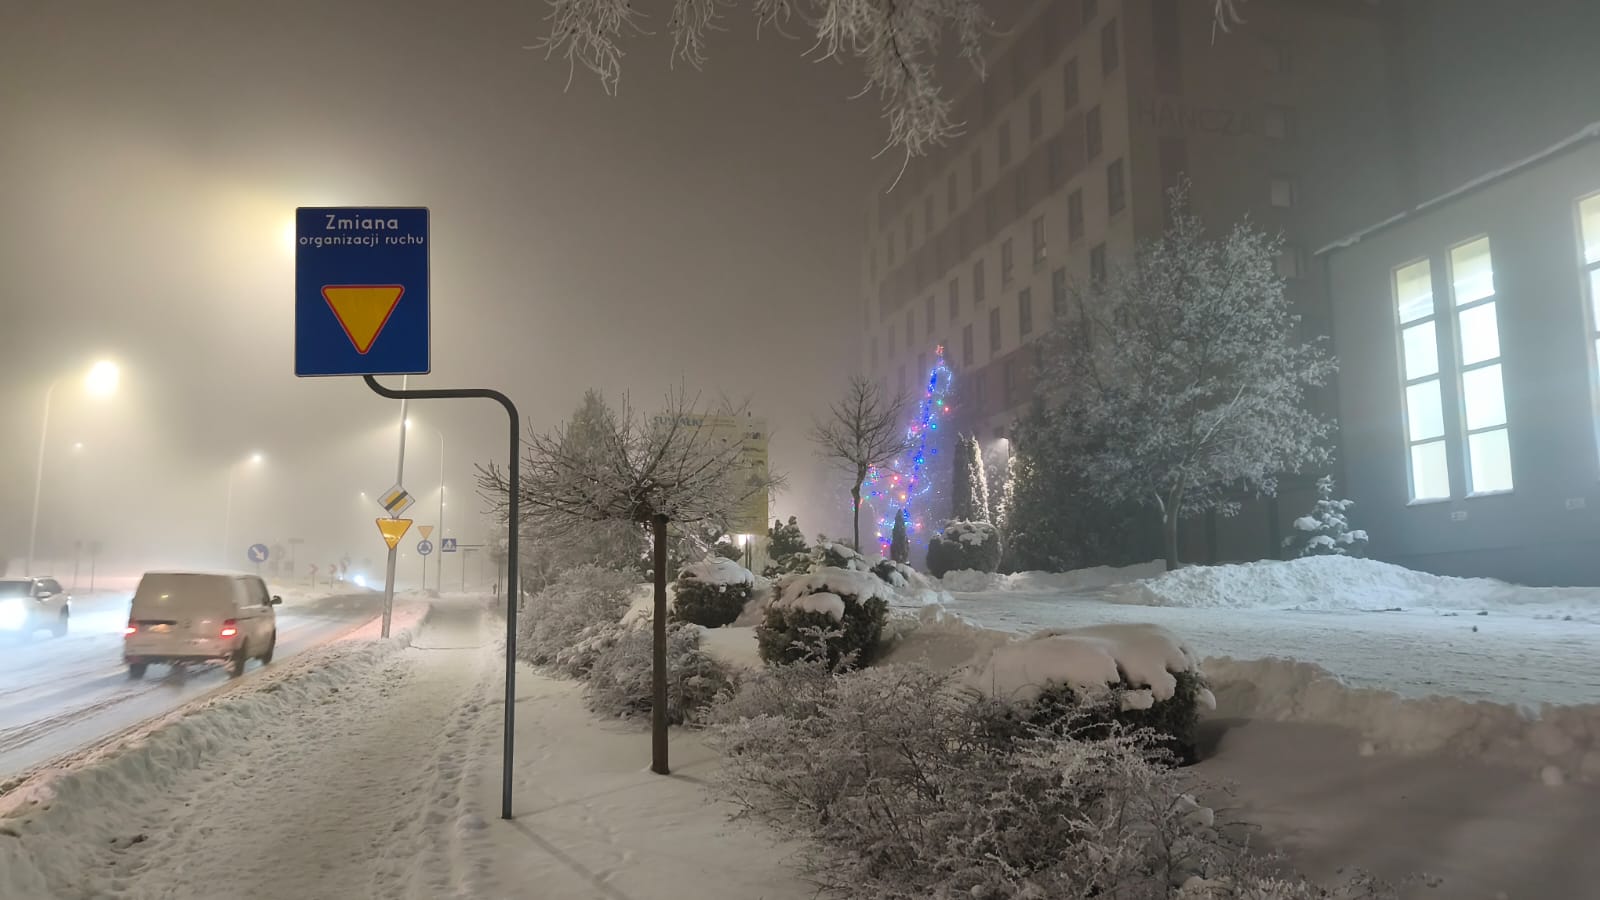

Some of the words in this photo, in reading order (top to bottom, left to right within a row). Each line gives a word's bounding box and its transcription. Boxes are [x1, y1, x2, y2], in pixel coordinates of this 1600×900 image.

[326, 214, 399, 230] Zmiana
[299, 233, 379, 248] organizacji
[385, 233, 424, 246] ruchu
